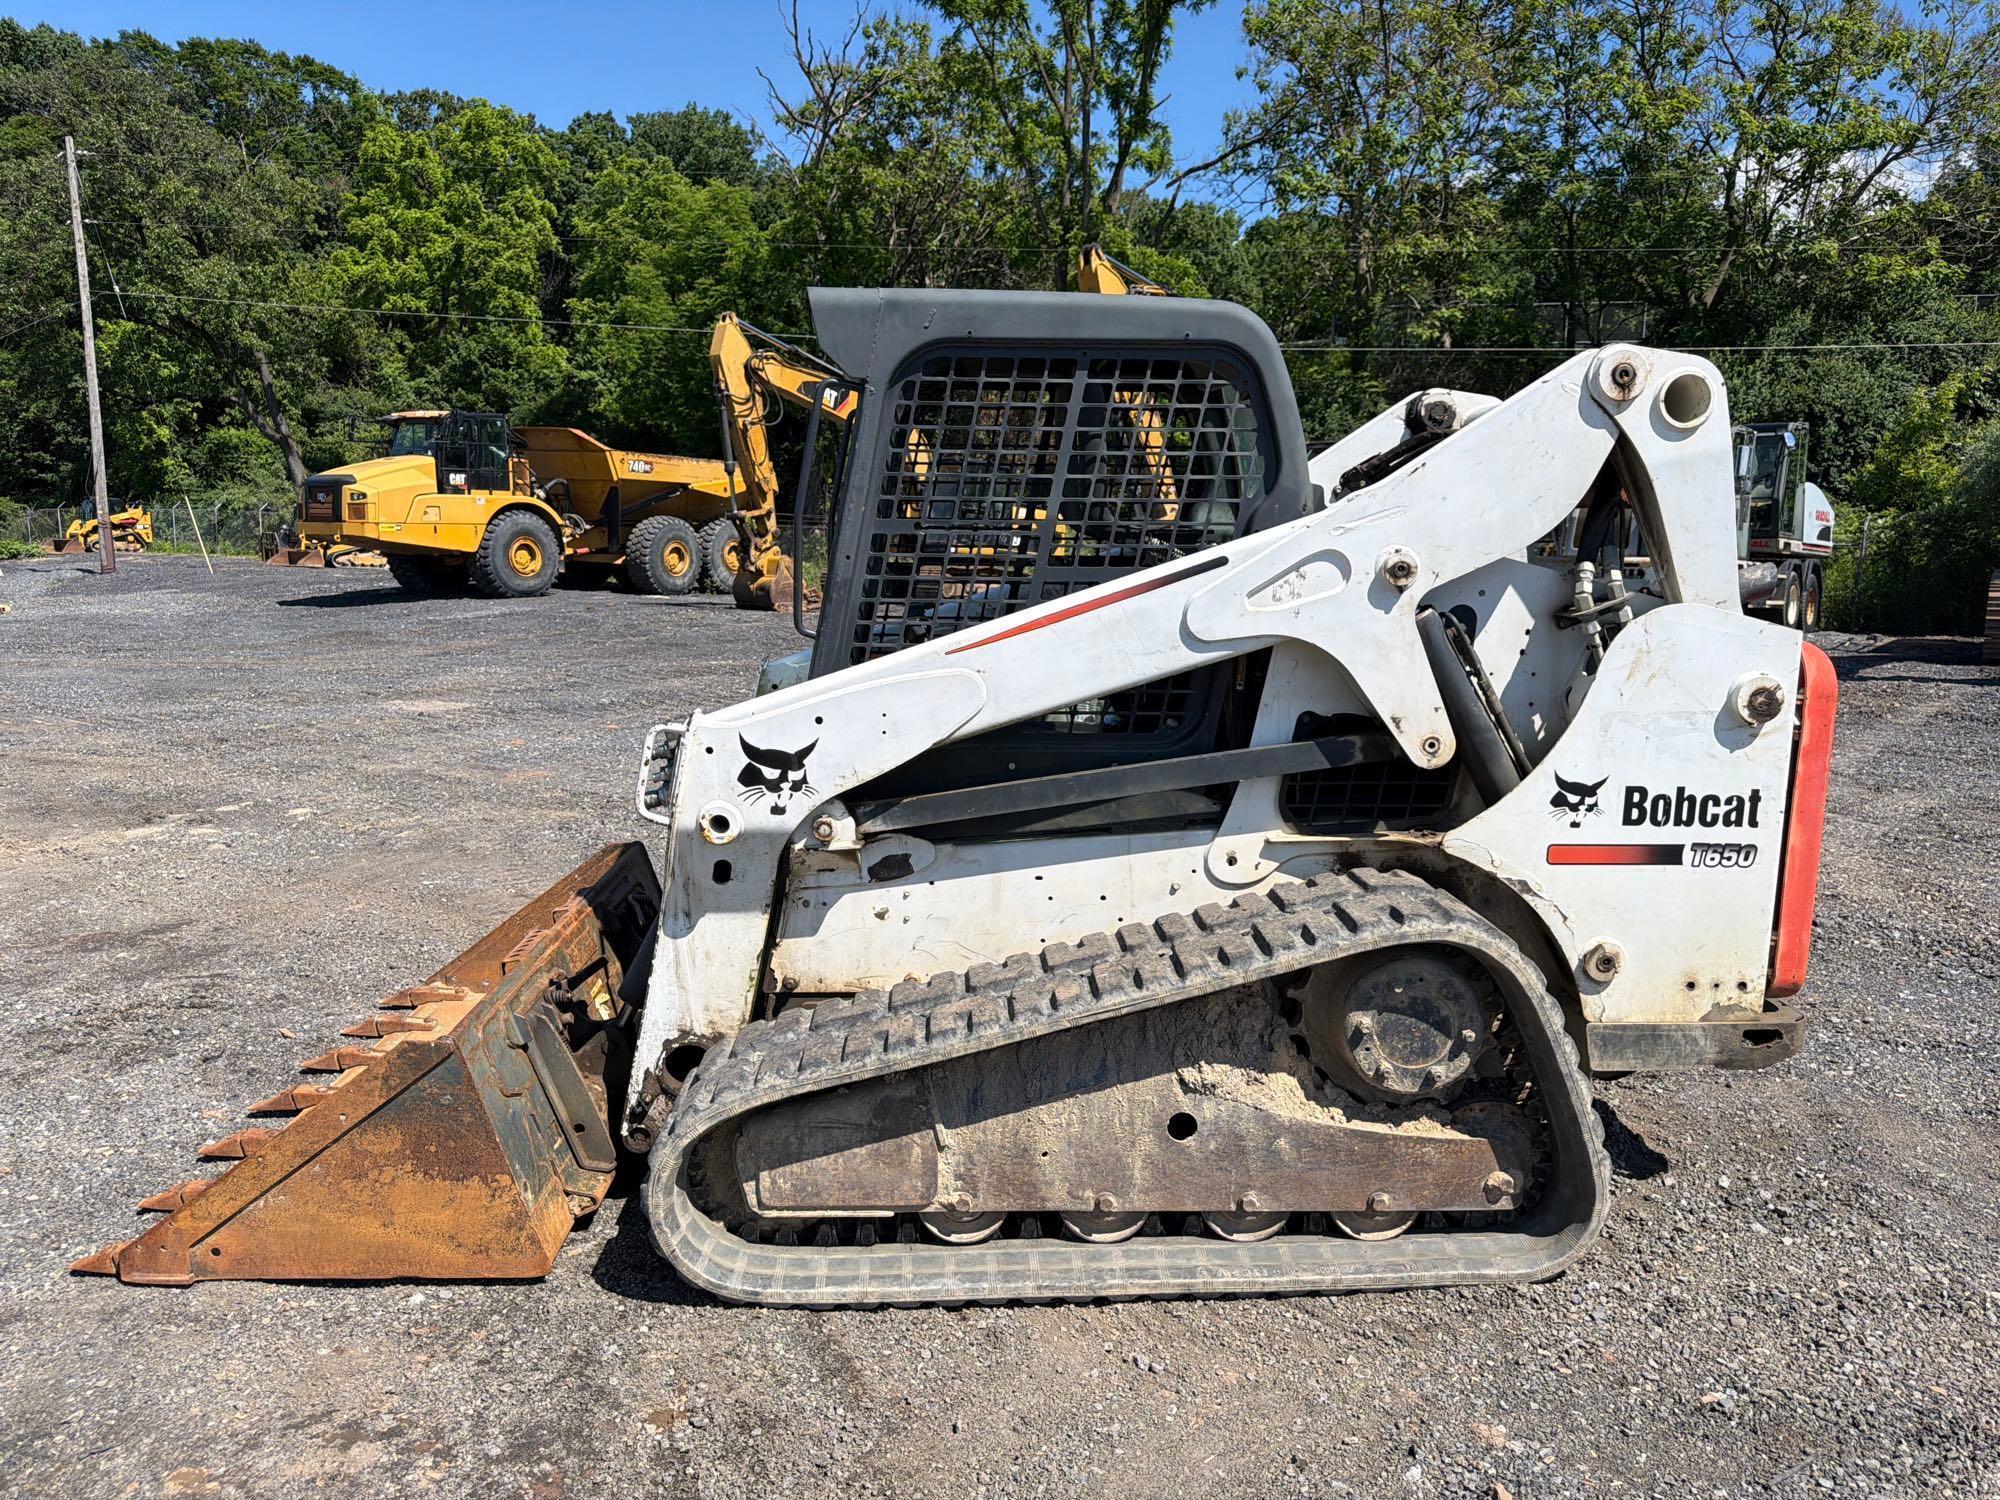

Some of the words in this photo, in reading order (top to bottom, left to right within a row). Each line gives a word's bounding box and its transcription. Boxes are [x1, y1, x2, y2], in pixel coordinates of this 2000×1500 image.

[822, 387, 838, 409] AT
[627, 459, 645, 473] 740
[449, 472, 466, 485] CAT
[1622, 785, 1762, 828] Bobcat
[1689, 842, 1758, 868] T650
